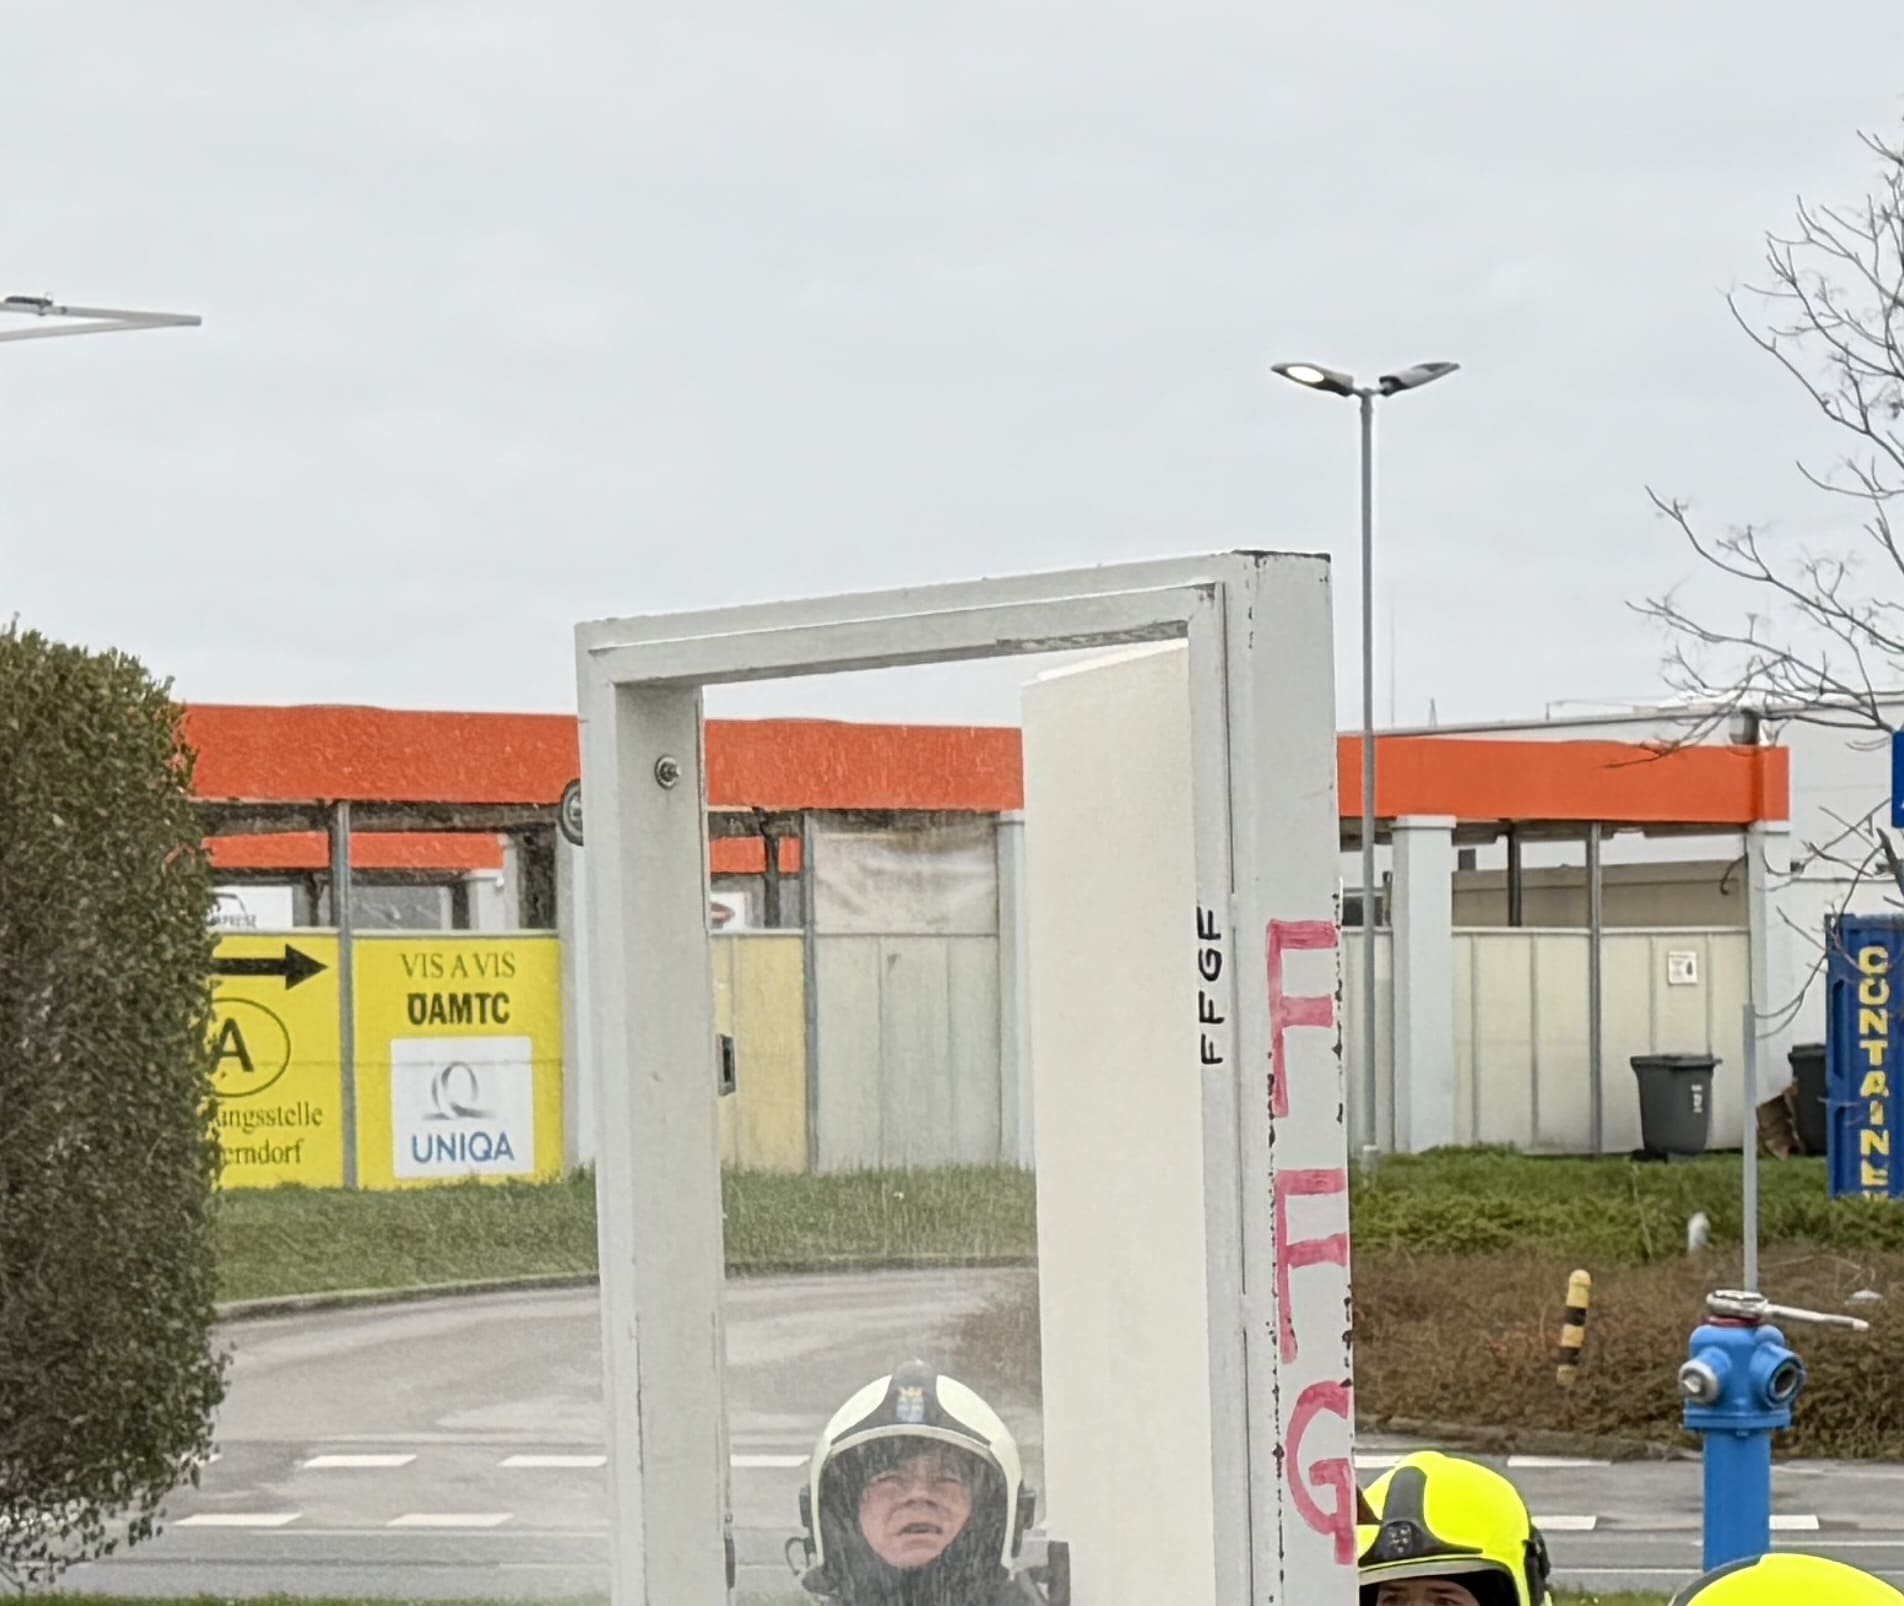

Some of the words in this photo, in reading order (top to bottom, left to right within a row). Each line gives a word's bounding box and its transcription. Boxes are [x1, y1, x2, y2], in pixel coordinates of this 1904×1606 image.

[400, 953, 443, 978] VIS
[451, 953, 469, 978] A
[472, 951, 516, 978] VIS
[1196, 906, 1225, 1065] FFGF
[412, 1131, 514, 1163] UNIQA
